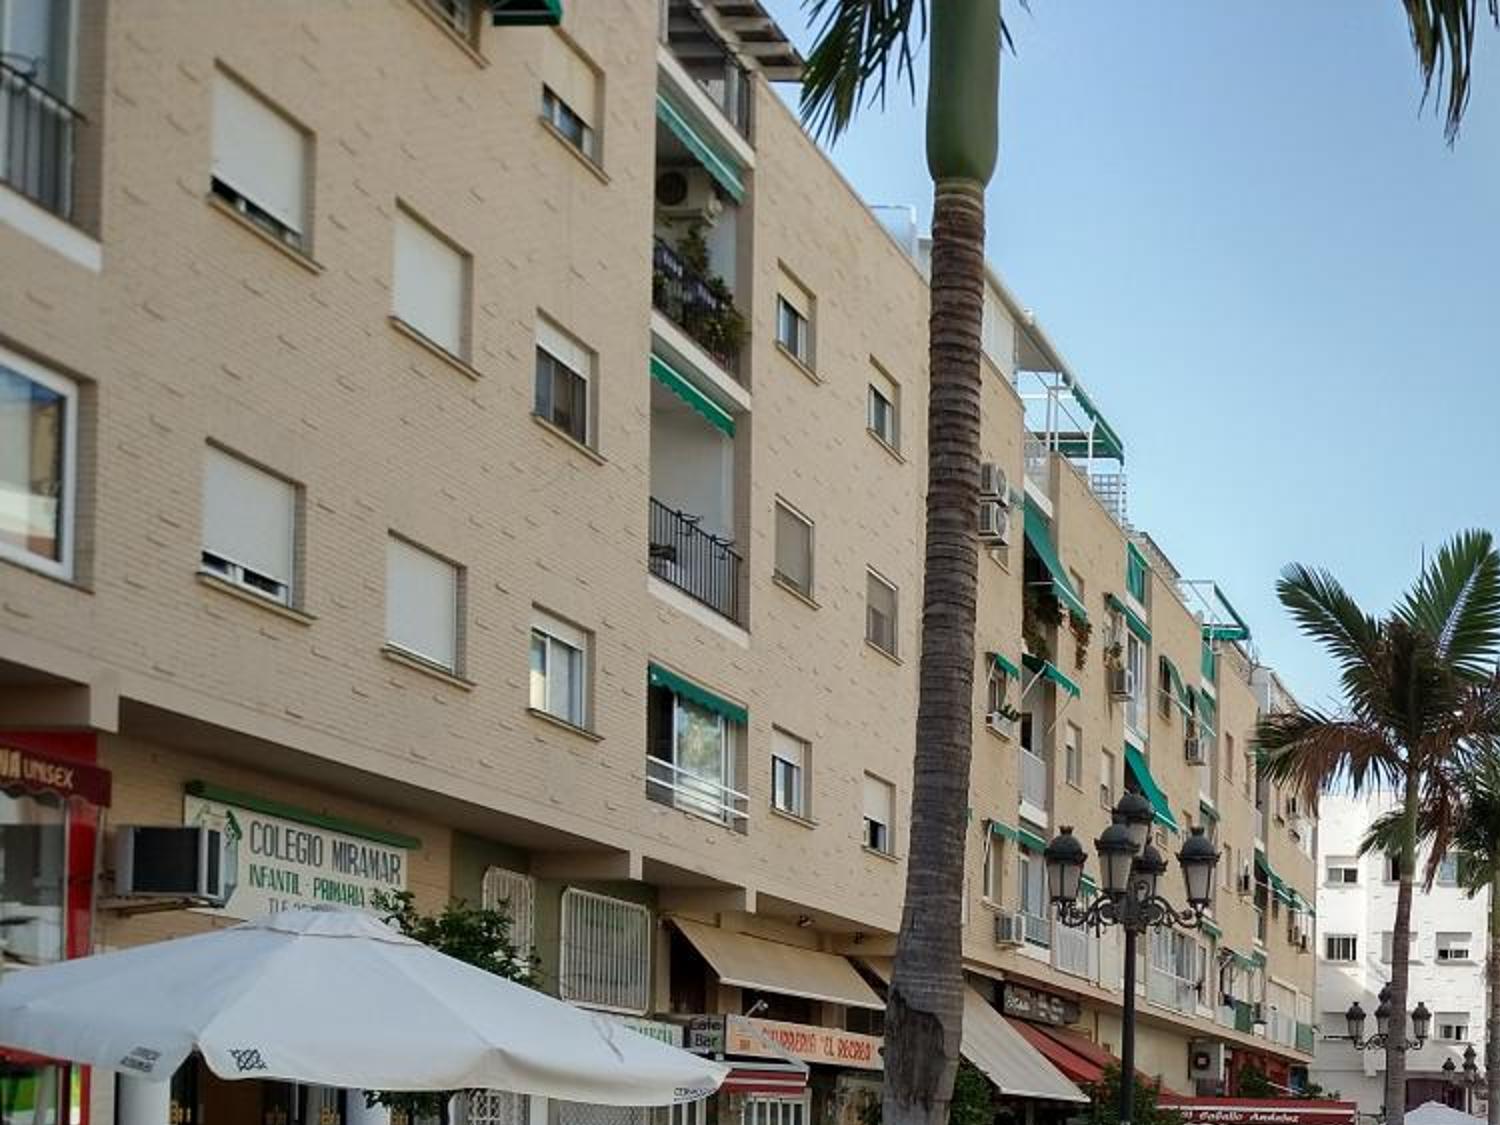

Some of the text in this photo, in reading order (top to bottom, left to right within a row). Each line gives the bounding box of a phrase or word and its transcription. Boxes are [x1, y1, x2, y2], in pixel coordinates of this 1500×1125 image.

[24, 758, 74, 790] UNISEX
[250, 820, 401, 884] COLEGIO MIRAMAR
[250, 863, 302, 896] INFANTIL
[313, 877, 366, 909] PRIMARIA
[695, 1033, 719, 1048] Bar
[1199, 1110, 1244, 1122] Caballo
[1249, 1112, 1300, 1123] Andaluz
